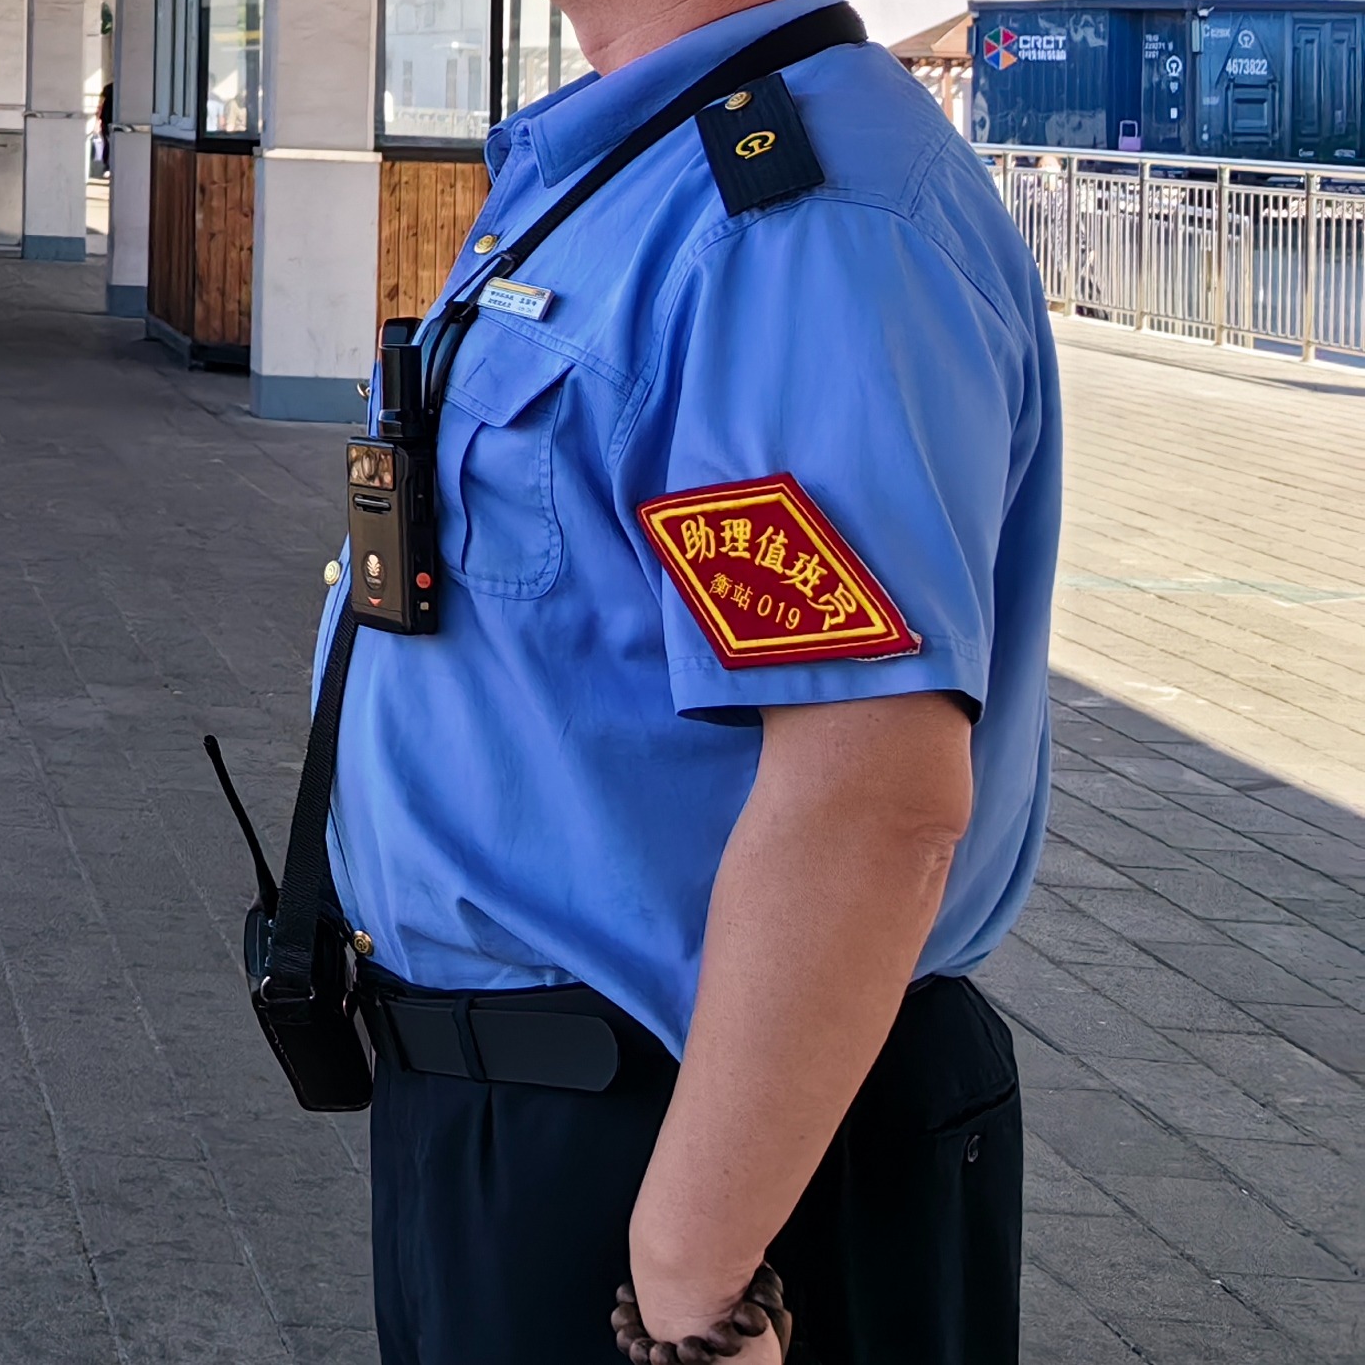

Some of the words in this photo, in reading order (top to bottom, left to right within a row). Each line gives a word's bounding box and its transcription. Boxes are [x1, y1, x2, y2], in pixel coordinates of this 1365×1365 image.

[1019, 35, 1067, 49] CRCT
[680, 514, 858, 631] 助理值班员
